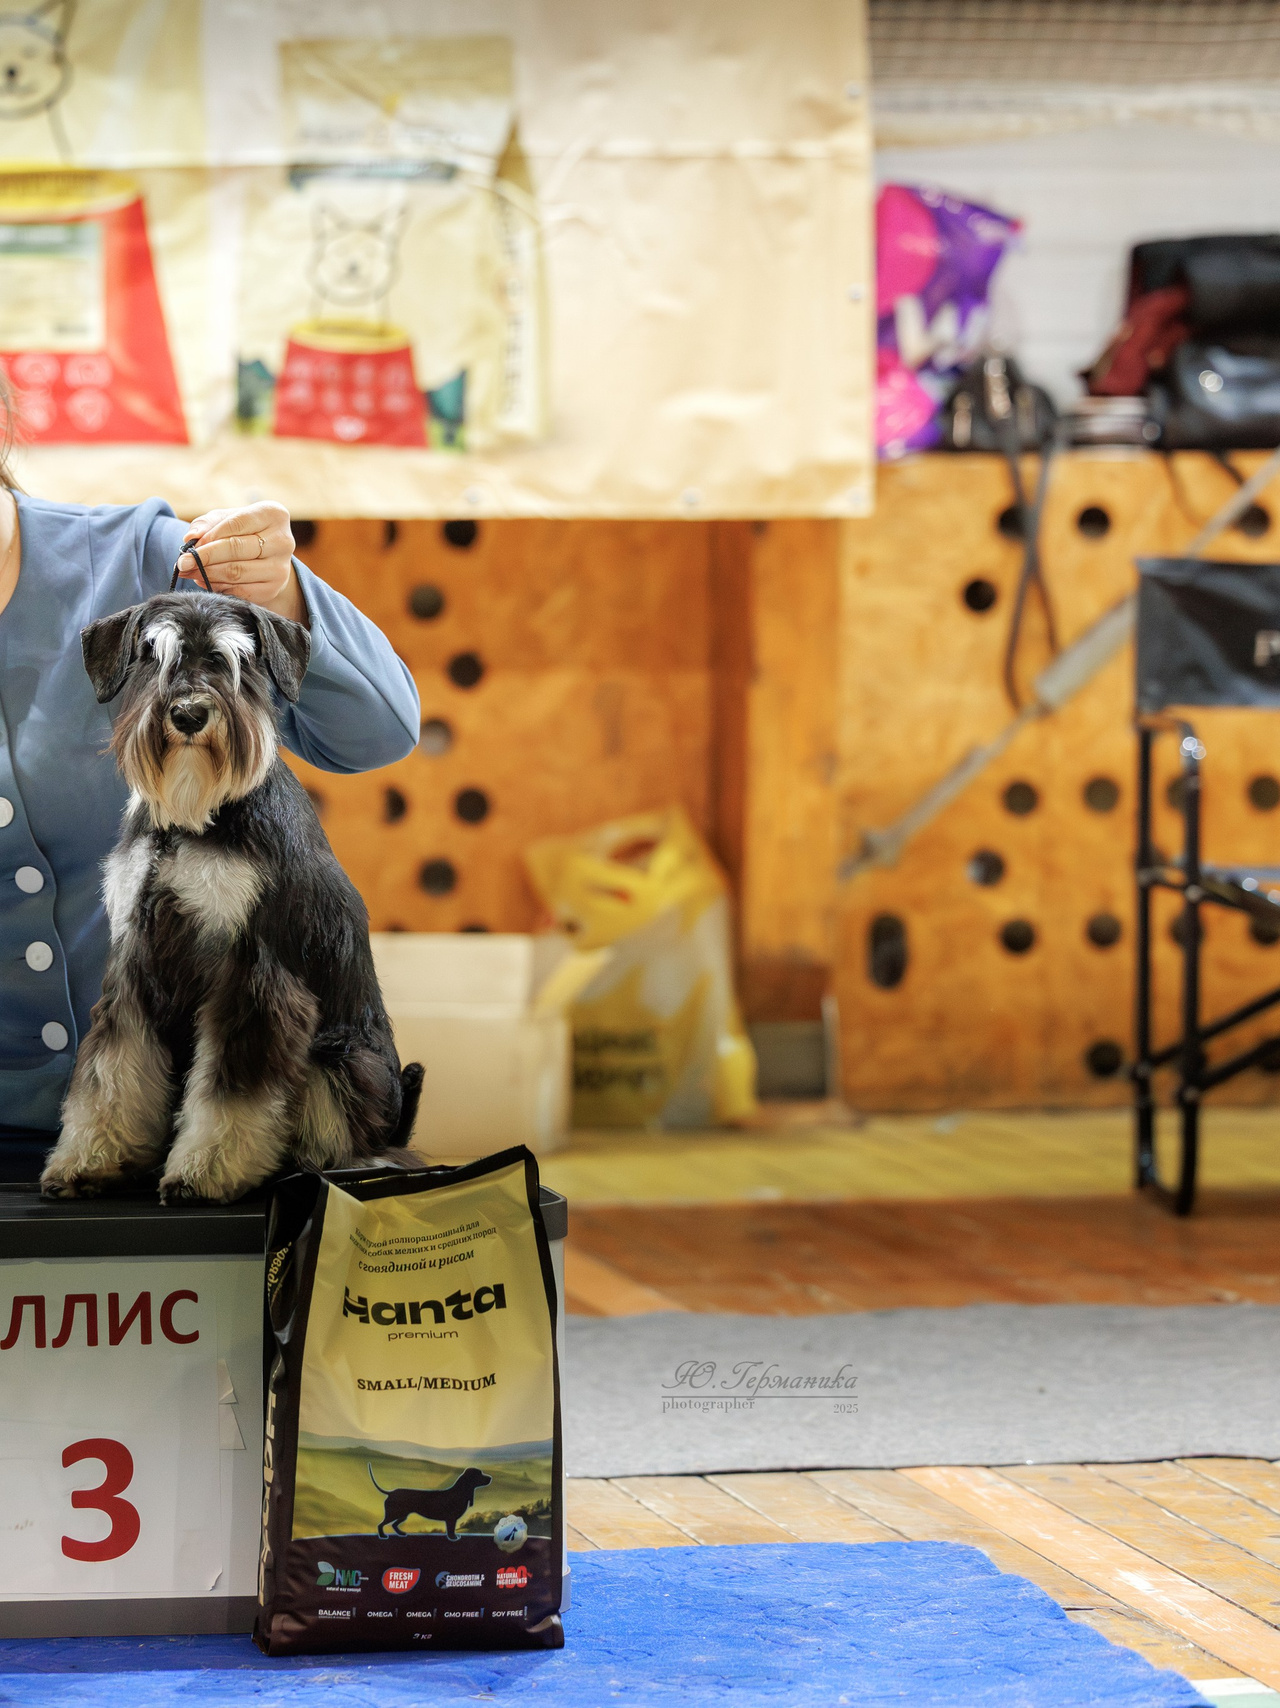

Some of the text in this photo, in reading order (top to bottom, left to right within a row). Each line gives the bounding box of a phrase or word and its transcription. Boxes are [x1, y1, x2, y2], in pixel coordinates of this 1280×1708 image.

[367, 1247, 394, 1257] собак
[394, 1245, 429, 1255] мелких
[437, 1234, 472, 1250] средних
[472, 1226, 497, 1240] пород
[388, 1225, 466, 1245] полнорационный
[465, 1220, 480, 1232] для
[358, 1249, 475, 1273] с говядиной и рисом
[387, 1329, 459, 1342] premium
[357, 1372, 497, 1392] SMALL/MEDIUM
[61, 1437, 141, 1563] 3
[335, 1569, 362, 1587] NWC
[388, 1581, 409, 1589] MEAT
[389, 1572, 413, 1580] FRESH
[318, 1609, 351, 1617] BALANCE
[506, 1609, 523, 1617] FREE
